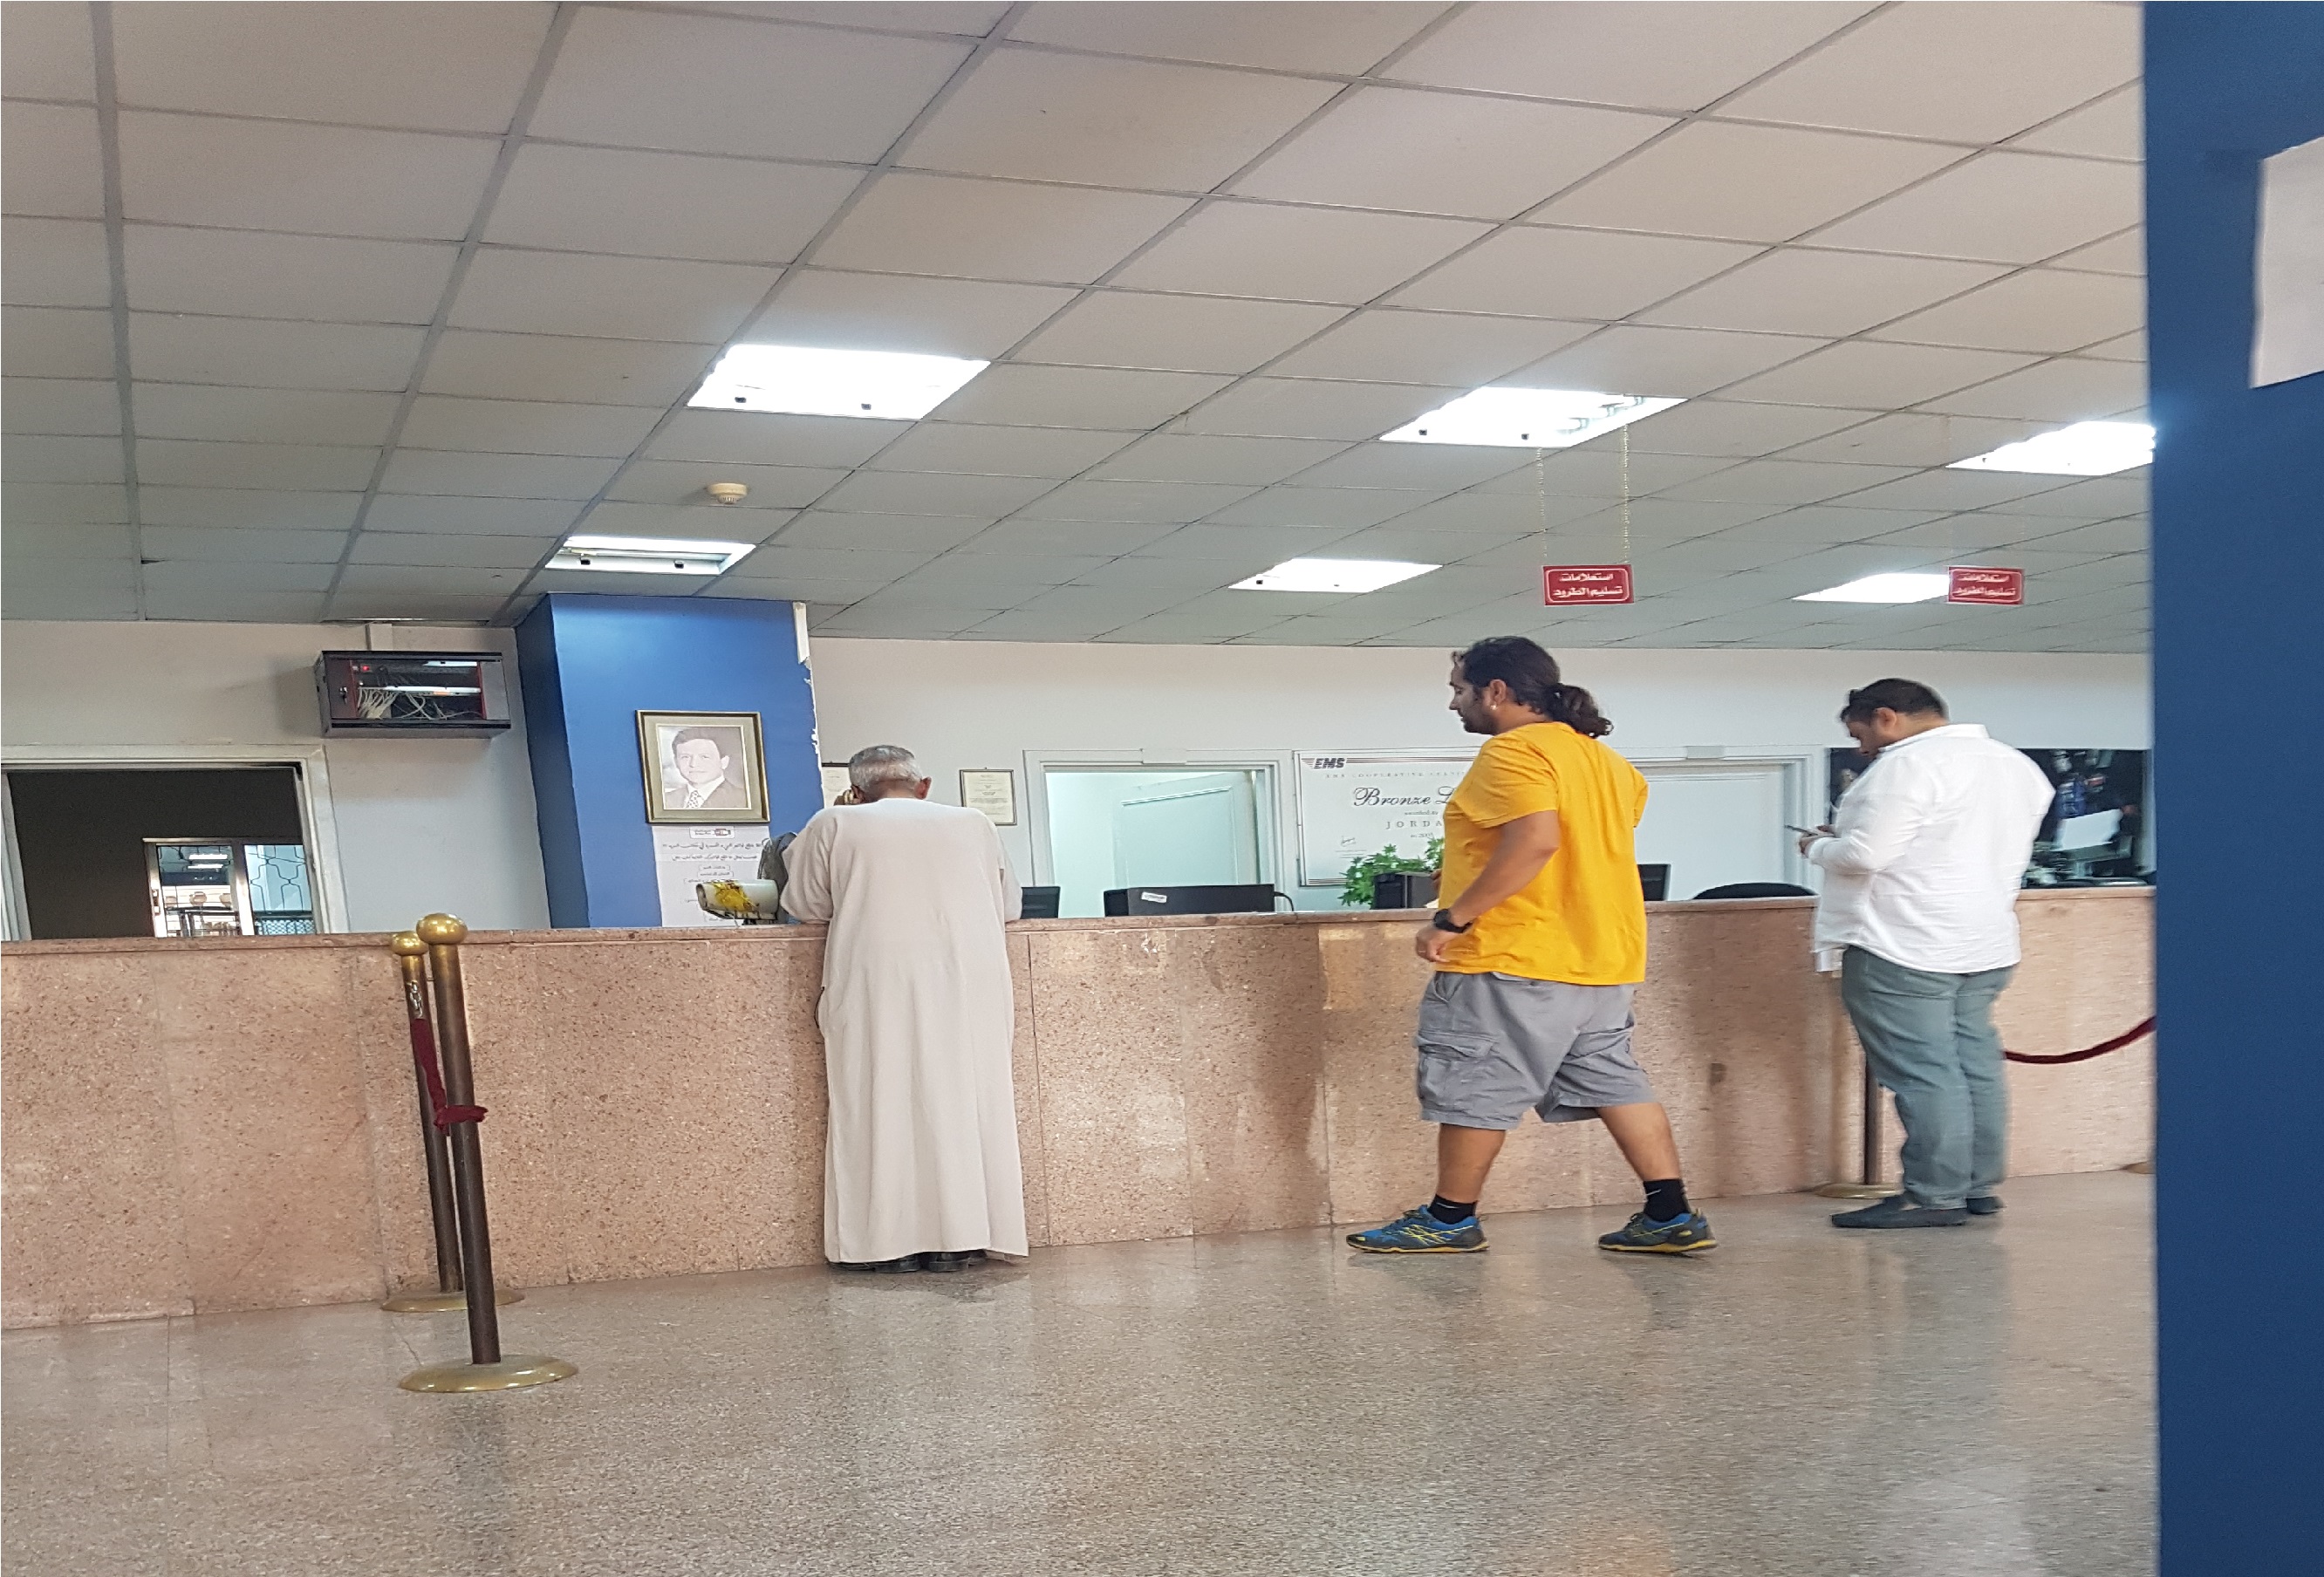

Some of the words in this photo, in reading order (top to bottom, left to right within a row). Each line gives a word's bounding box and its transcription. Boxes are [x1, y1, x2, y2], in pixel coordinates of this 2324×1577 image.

[1313, 757, 1346, 769] EMS
[1353, 787, 1432, 807] Bronze
[1385, 820, 1443, 829] JORDA
